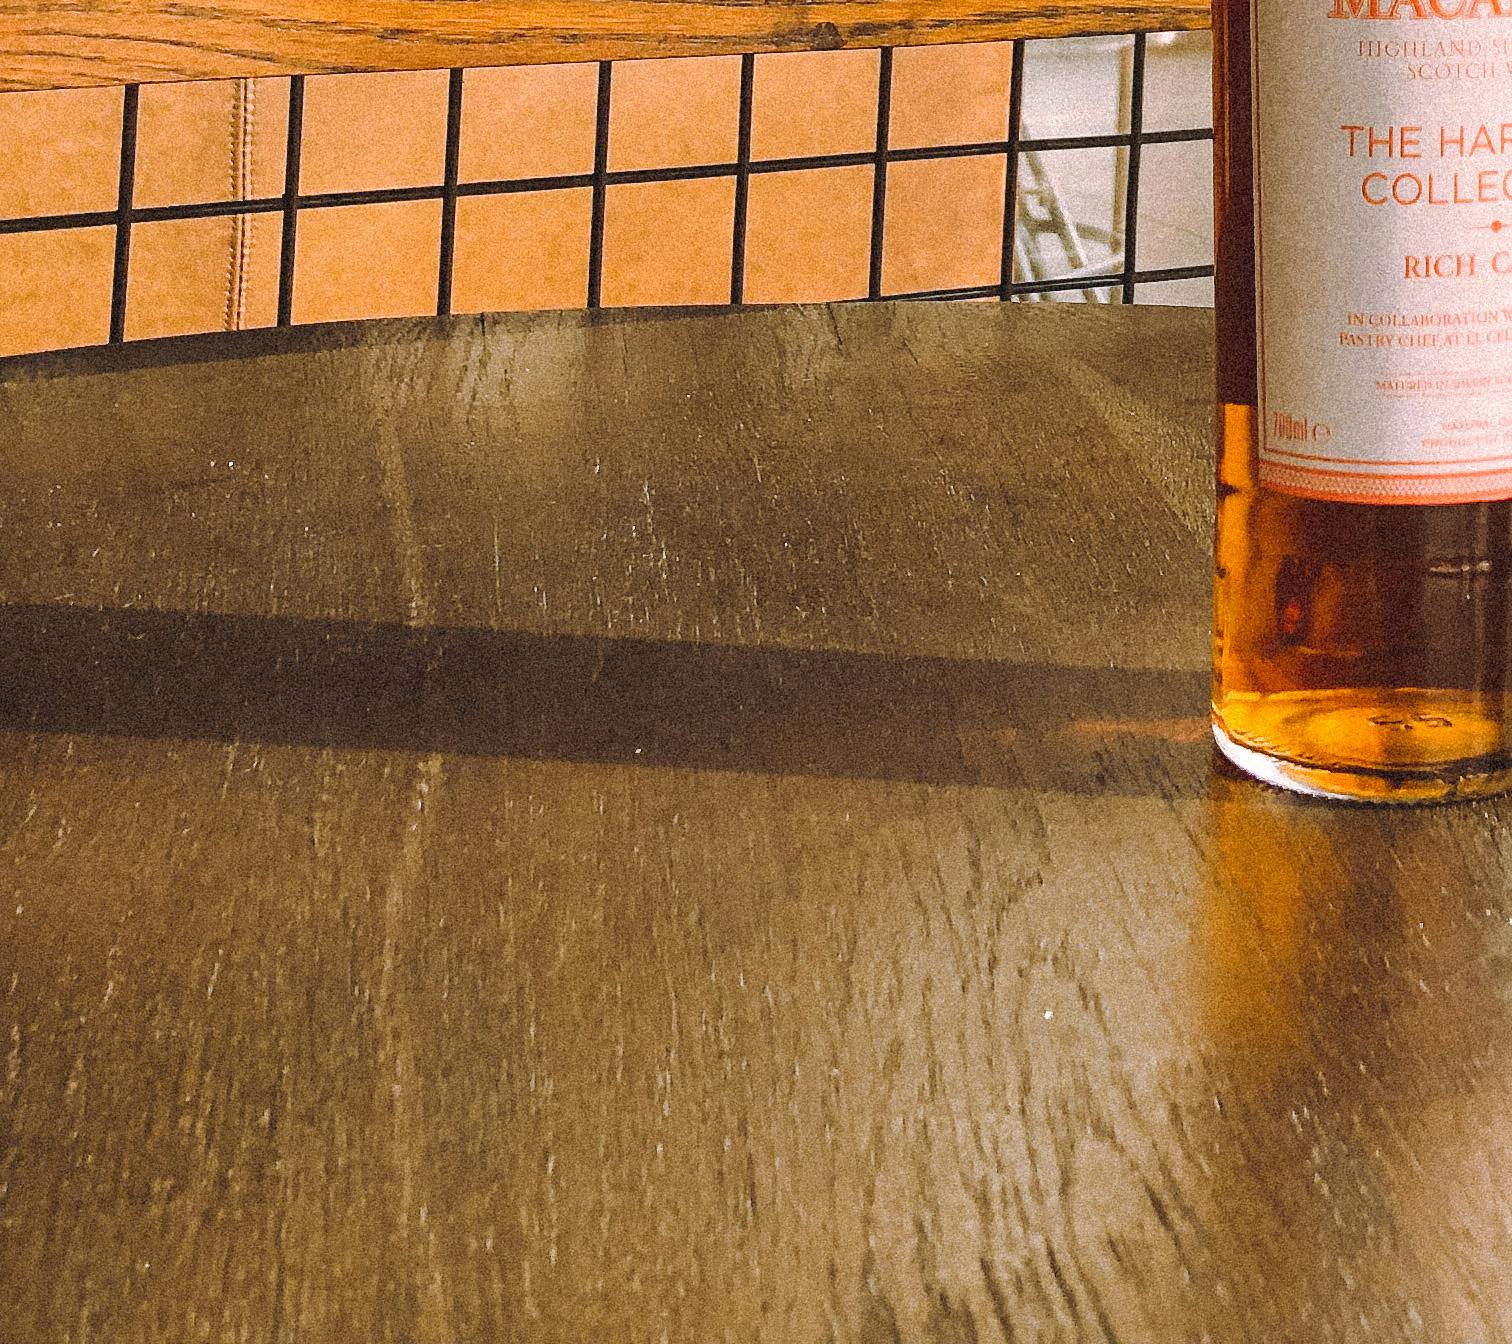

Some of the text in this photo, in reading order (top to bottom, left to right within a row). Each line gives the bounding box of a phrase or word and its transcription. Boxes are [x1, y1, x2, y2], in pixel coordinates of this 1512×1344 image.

[1358, 39, 1482, 58] HIGHLAND
[1407, 62, 1496, 80] SCOTCH
[1341, 124, 1422, 159] THE
[1403, 253, 1476, 280] RICH
[1346, 313, 1365, 327] IN
[1368, 310, 1499, 328] COLLABORATION
[1339, 331, 1394, 348] PASTRY
[1398, 333, 1437, 348] CHEF
